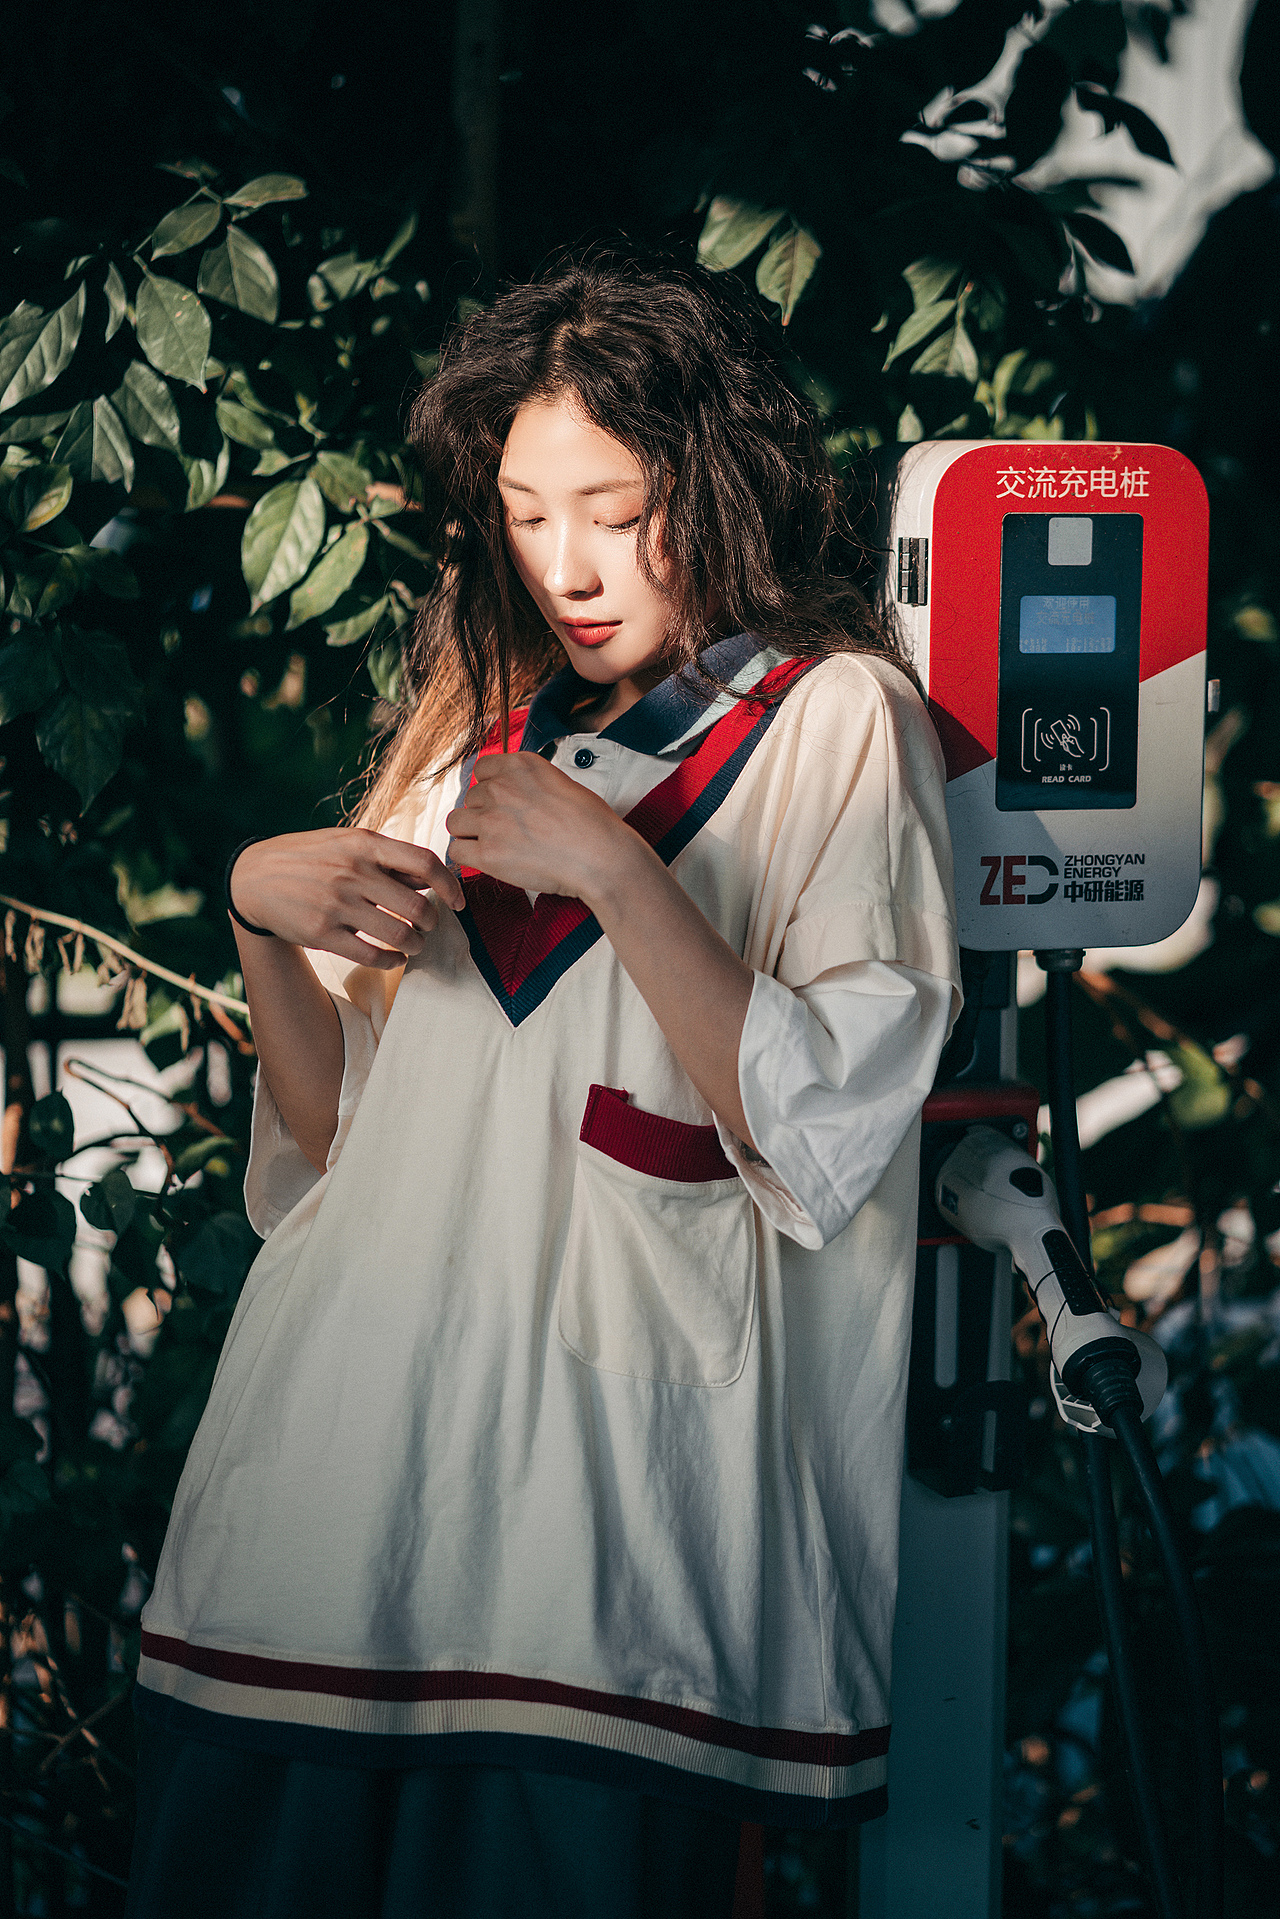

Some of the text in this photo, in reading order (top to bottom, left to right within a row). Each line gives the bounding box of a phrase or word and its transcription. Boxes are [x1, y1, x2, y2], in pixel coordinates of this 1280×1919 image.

[996, 466, 1150, 498] 交流充电桩
[1042, 775, 1092, 783] READ CARD
[1064, 854, 1145, 866] ZHONGYAN
[1064, 866, 1121, 878] ENERGY
[1064, 880, 1144, 903] 中研能源
